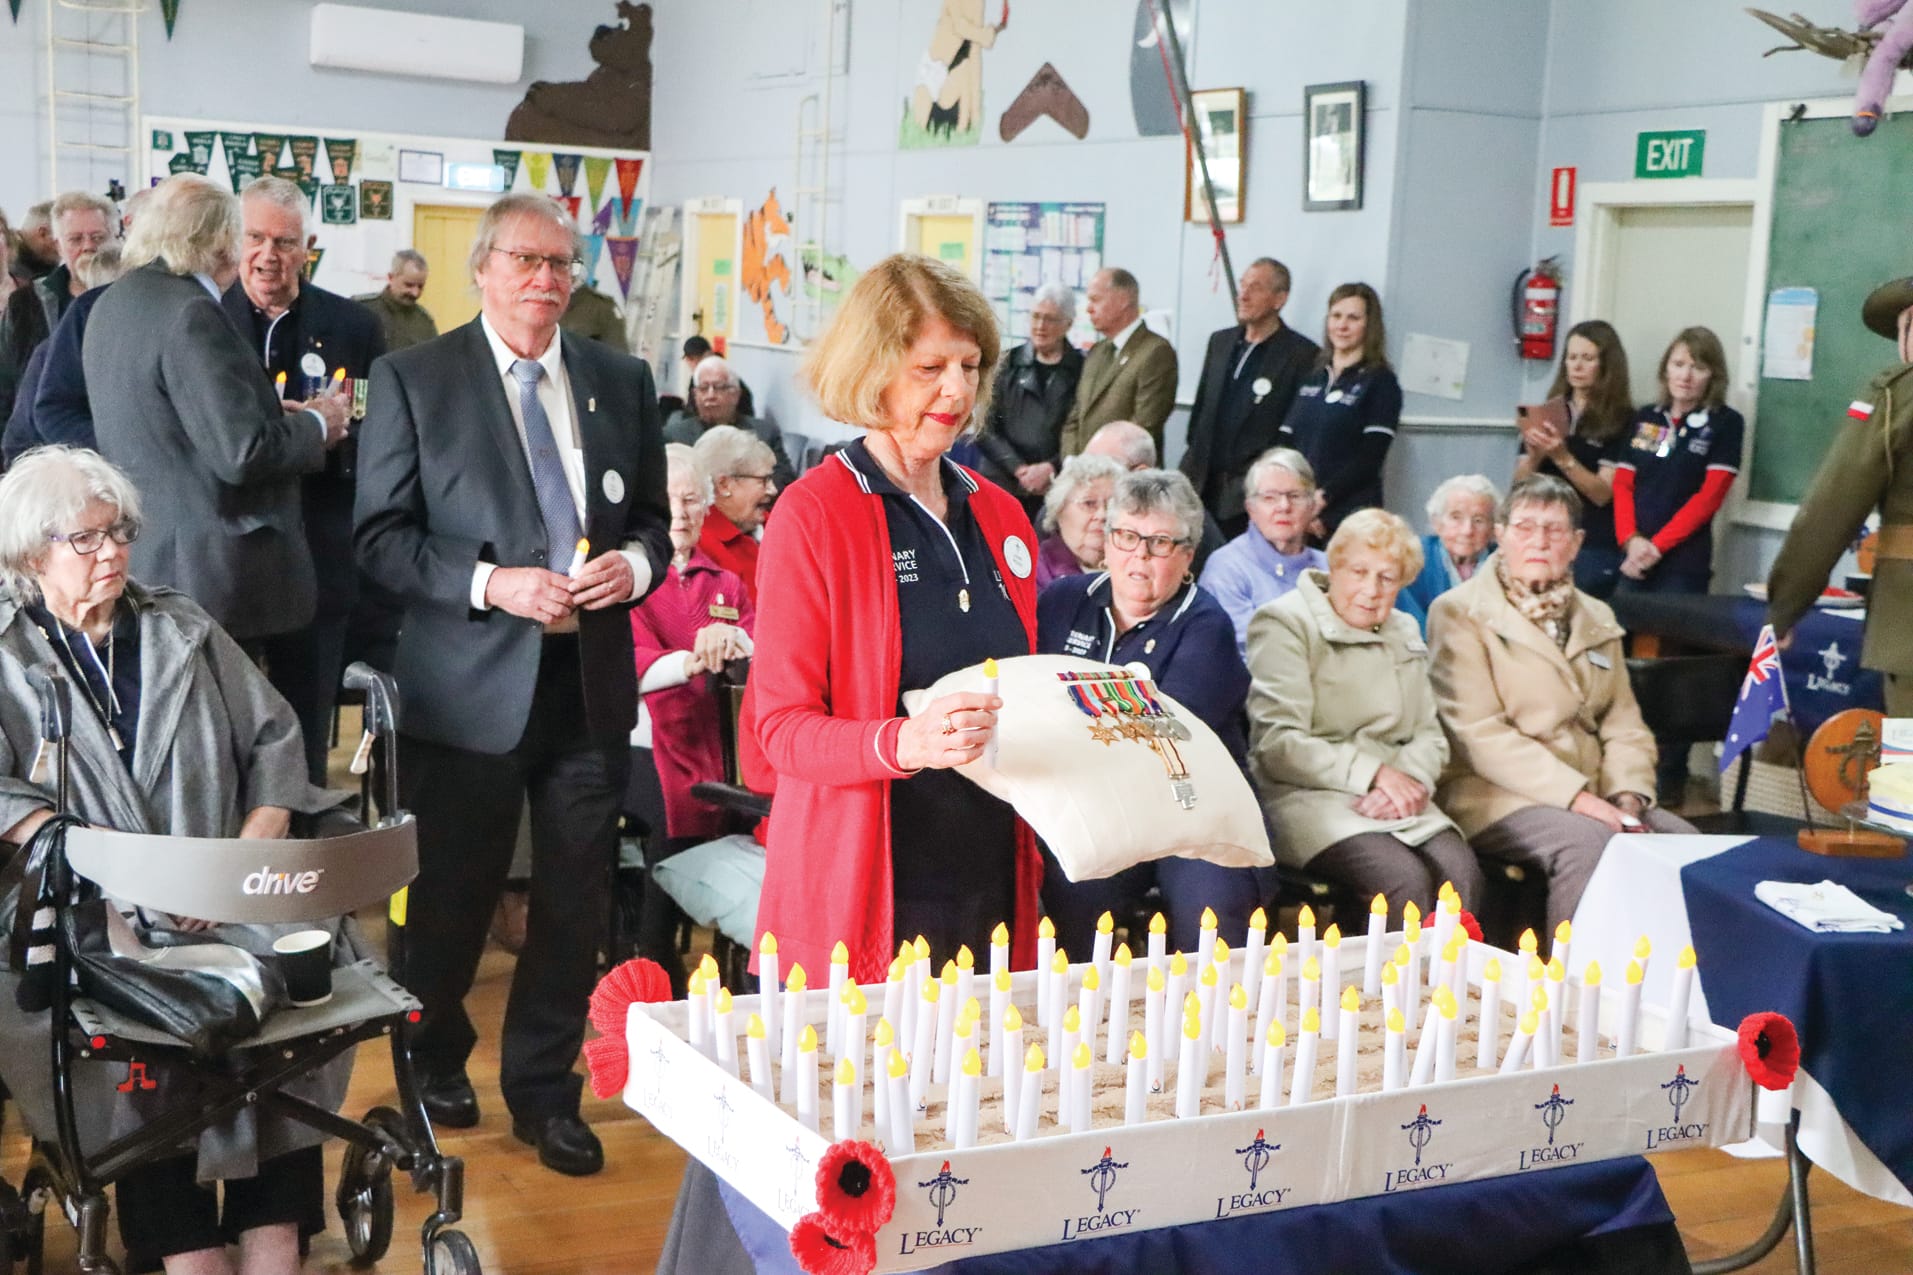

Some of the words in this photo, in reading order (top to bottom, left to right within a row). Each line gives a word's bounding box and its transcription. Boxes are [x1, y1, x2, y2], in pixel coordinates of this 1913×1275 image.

[1646, 138, 1694, 171] EXIT
[898, 573, 919, 583] 2023
[243, 866, 319, 894] drive
[1646, 1124, 1706, 1149] LEGACY
[1519, 1143, 1580, 1170] LEGACY
[1384, 1164, 1449, 1192] LEGACY
[1215, 1189, 1286, 1218] LEGACY
[1062, 1209, 1136, 1240] LEGACY
[900, 1227, 978, 1255] LEGACY
